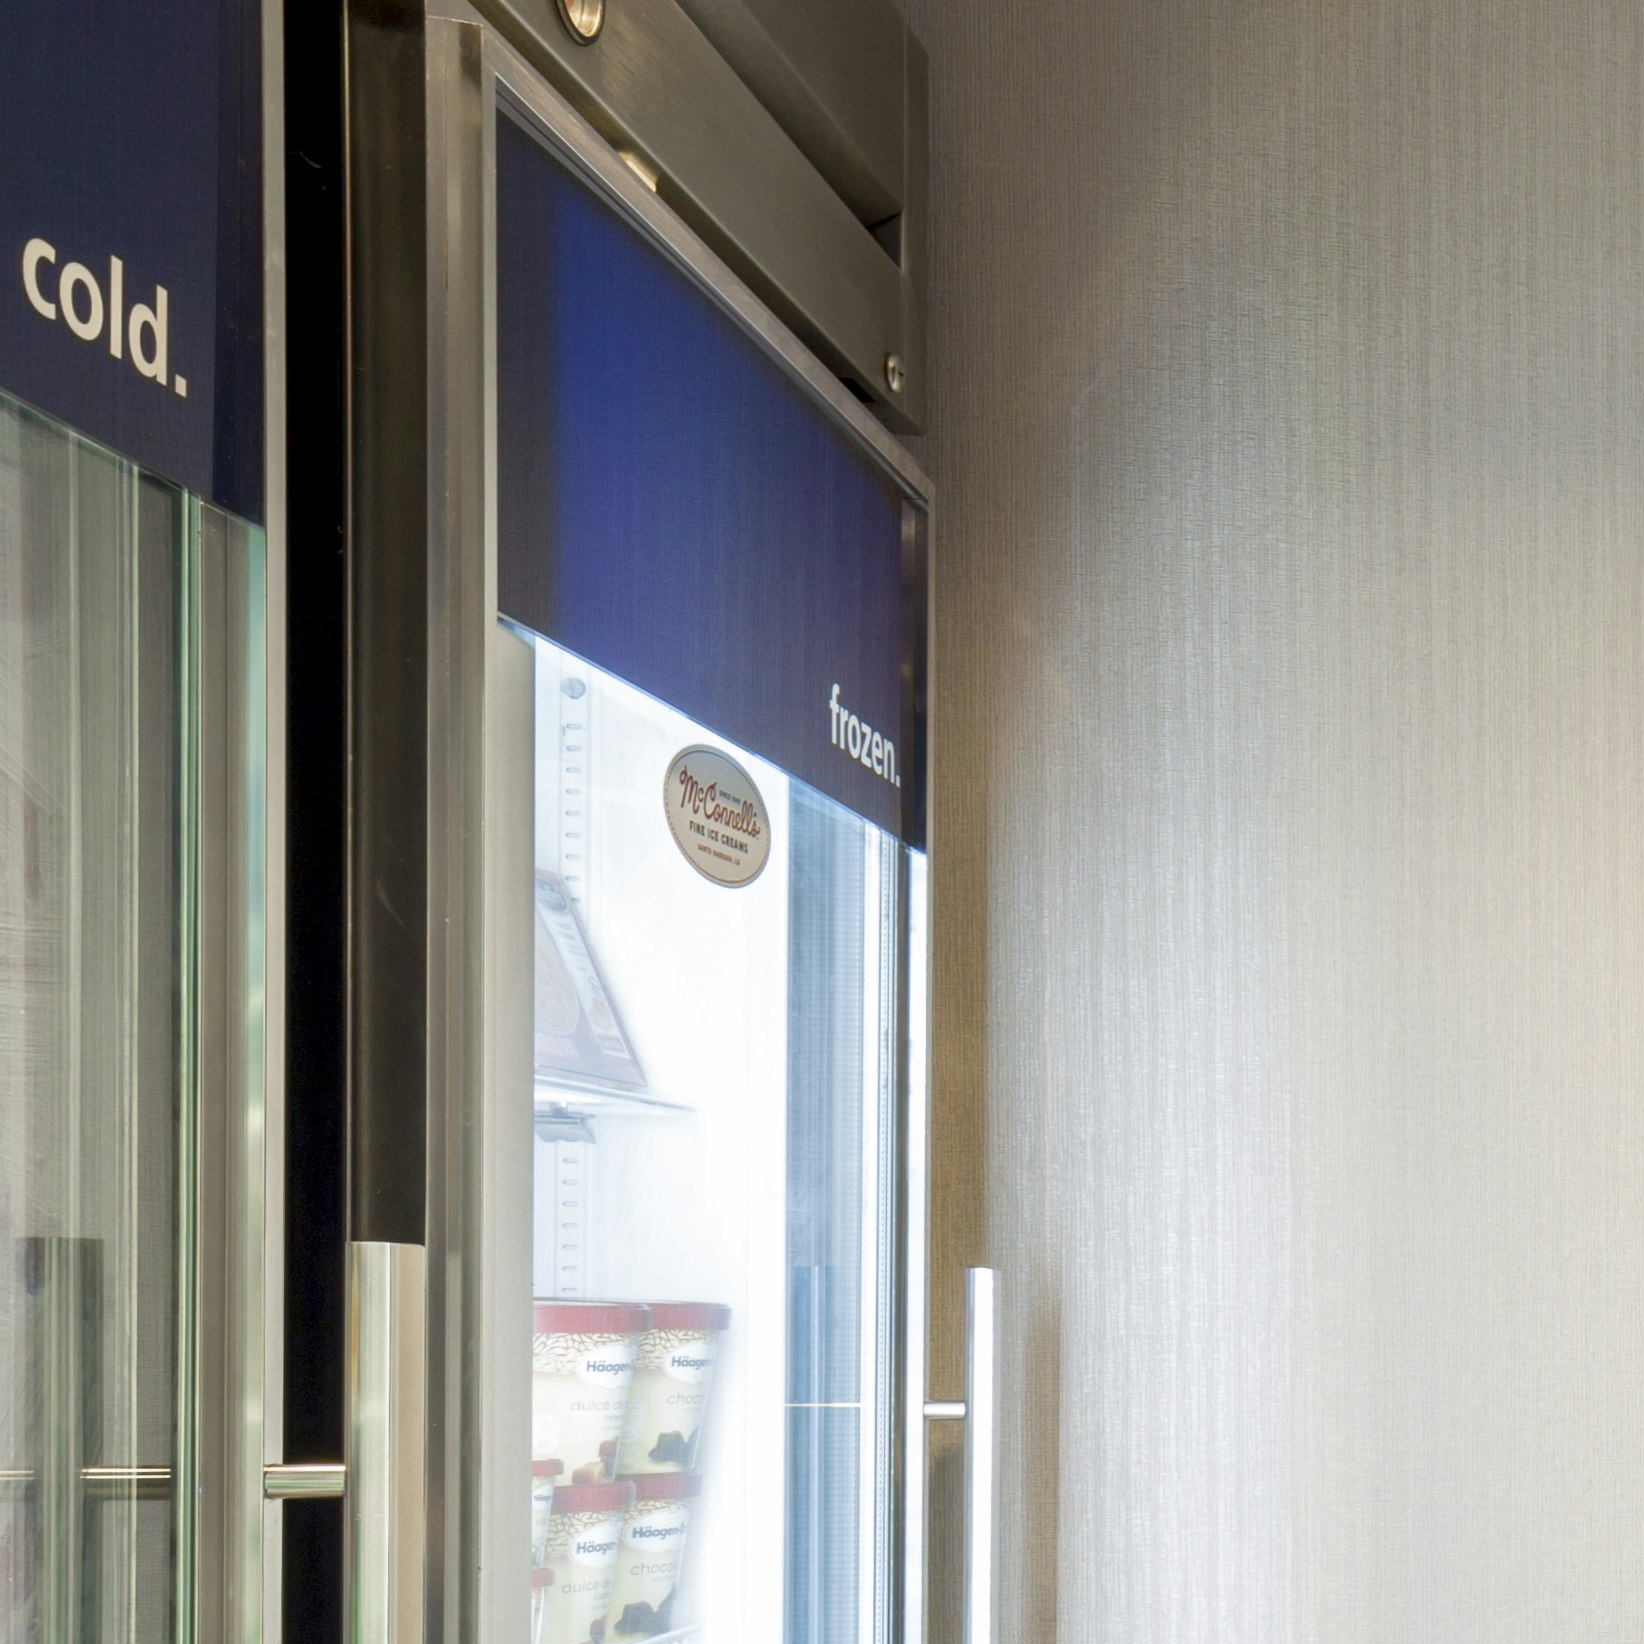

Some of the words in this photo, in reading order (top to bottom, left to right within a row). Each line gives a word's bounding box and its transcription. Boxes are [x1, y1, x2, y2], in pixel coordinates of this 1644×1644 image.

[23, 238, 187, 398] cold.
[829, 683, 901, 788] frozen.
[689, 820, 705, 837] FINE
[708, 828, 719, 842] ICE
[721, 834, 748, 854] CREAMS
[570, 1400, 610, 1413] dulce
[561, 1579, 600, 1595] dulce
